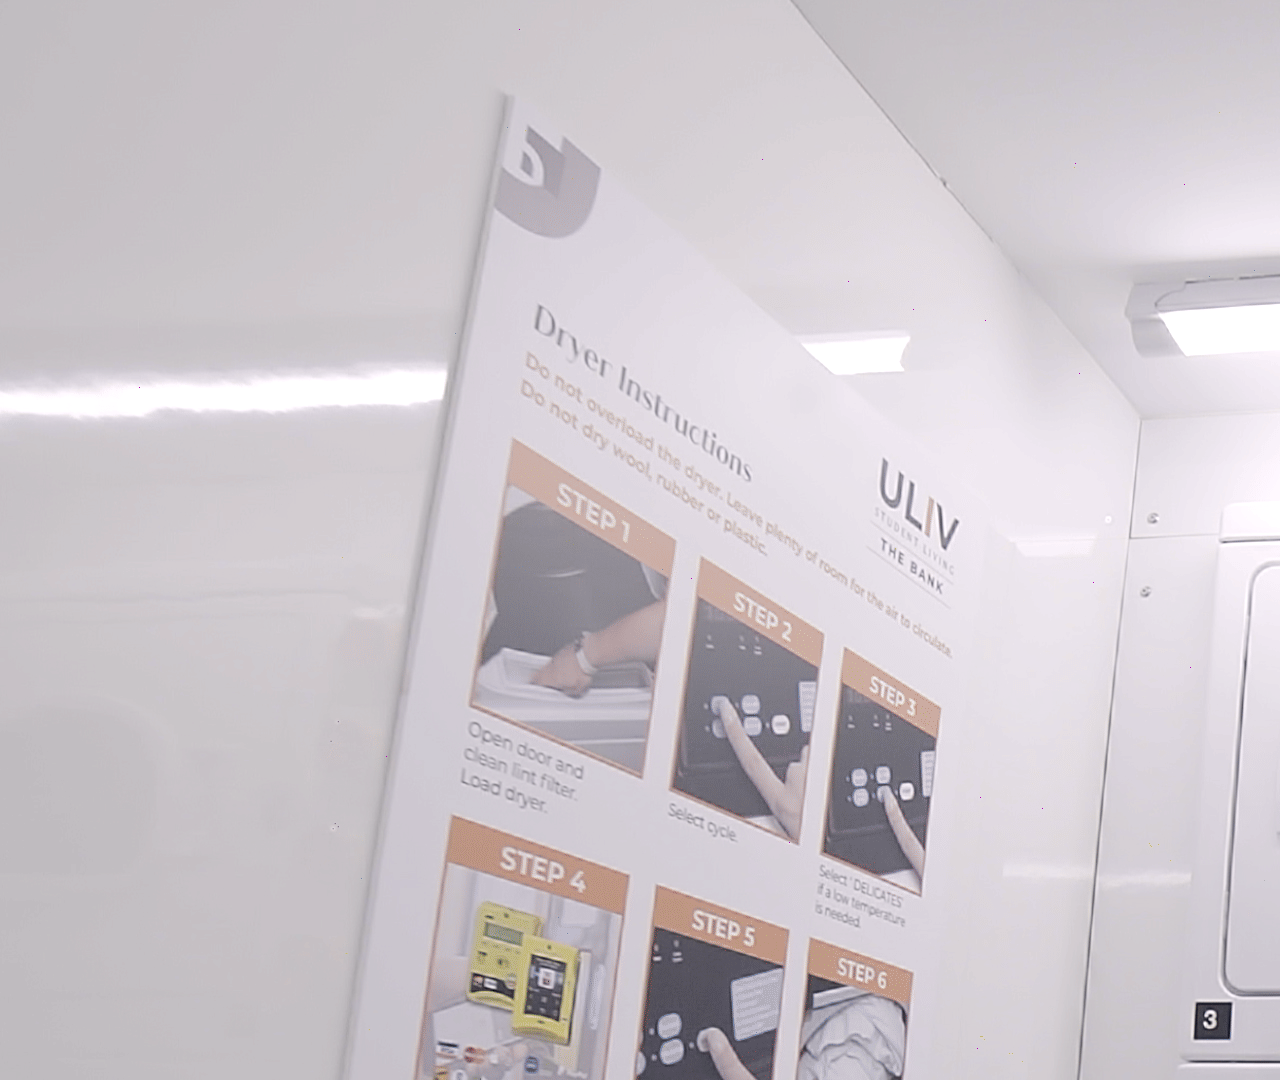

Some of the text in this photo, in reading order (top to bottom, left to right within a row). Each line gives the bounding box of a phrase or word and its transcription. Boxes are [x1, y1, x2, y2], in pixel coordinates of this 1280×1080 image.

[534, 303, 752, 482] Dryer Instructions
[521, 378, 768, 557] Do not dry wool, rubber or plastic.
[526, 352, 550, 379] Do
[554, 374, 582, 403] not
[587, 398, 655, 451] overload
[658, 444, 682, 471] the
[685, 462, 723, 501] dryer.
[726, 492, 763, 527] Leave
[766, 520, 802, 556] plenty
[806, 549, 818, 564] of
[820, 561, 848, 586] room
[850, 579, 865, 598] for
[867, 591, 883, 611] the
[885, 605, 898, 619] air
[900, 614, 910, 628] to
[557, 483, 631, 543] STEP 1
[880, 457, 959, 550] ULIV
[881, 538, 943, 594] THE BANK
[734, 592, 792, 642] STEP 2
[869, 676, 917, 716] STEP 3
[464, 747, 578, 801] clean lint filter.
[468, 721, 584, 780] Open door and
[460, 768, 548, 814] Load dryer.
[668, 803, 738, 843] Select cycle.
[500, 846, 587, 893] STEP 4
[819, 864, 847, 886] Select
[691, 909, 755, 947] STEP 5
[838, 957, 888, 989] STEP 6
[1203, 1010, 1217, 1029] 3
